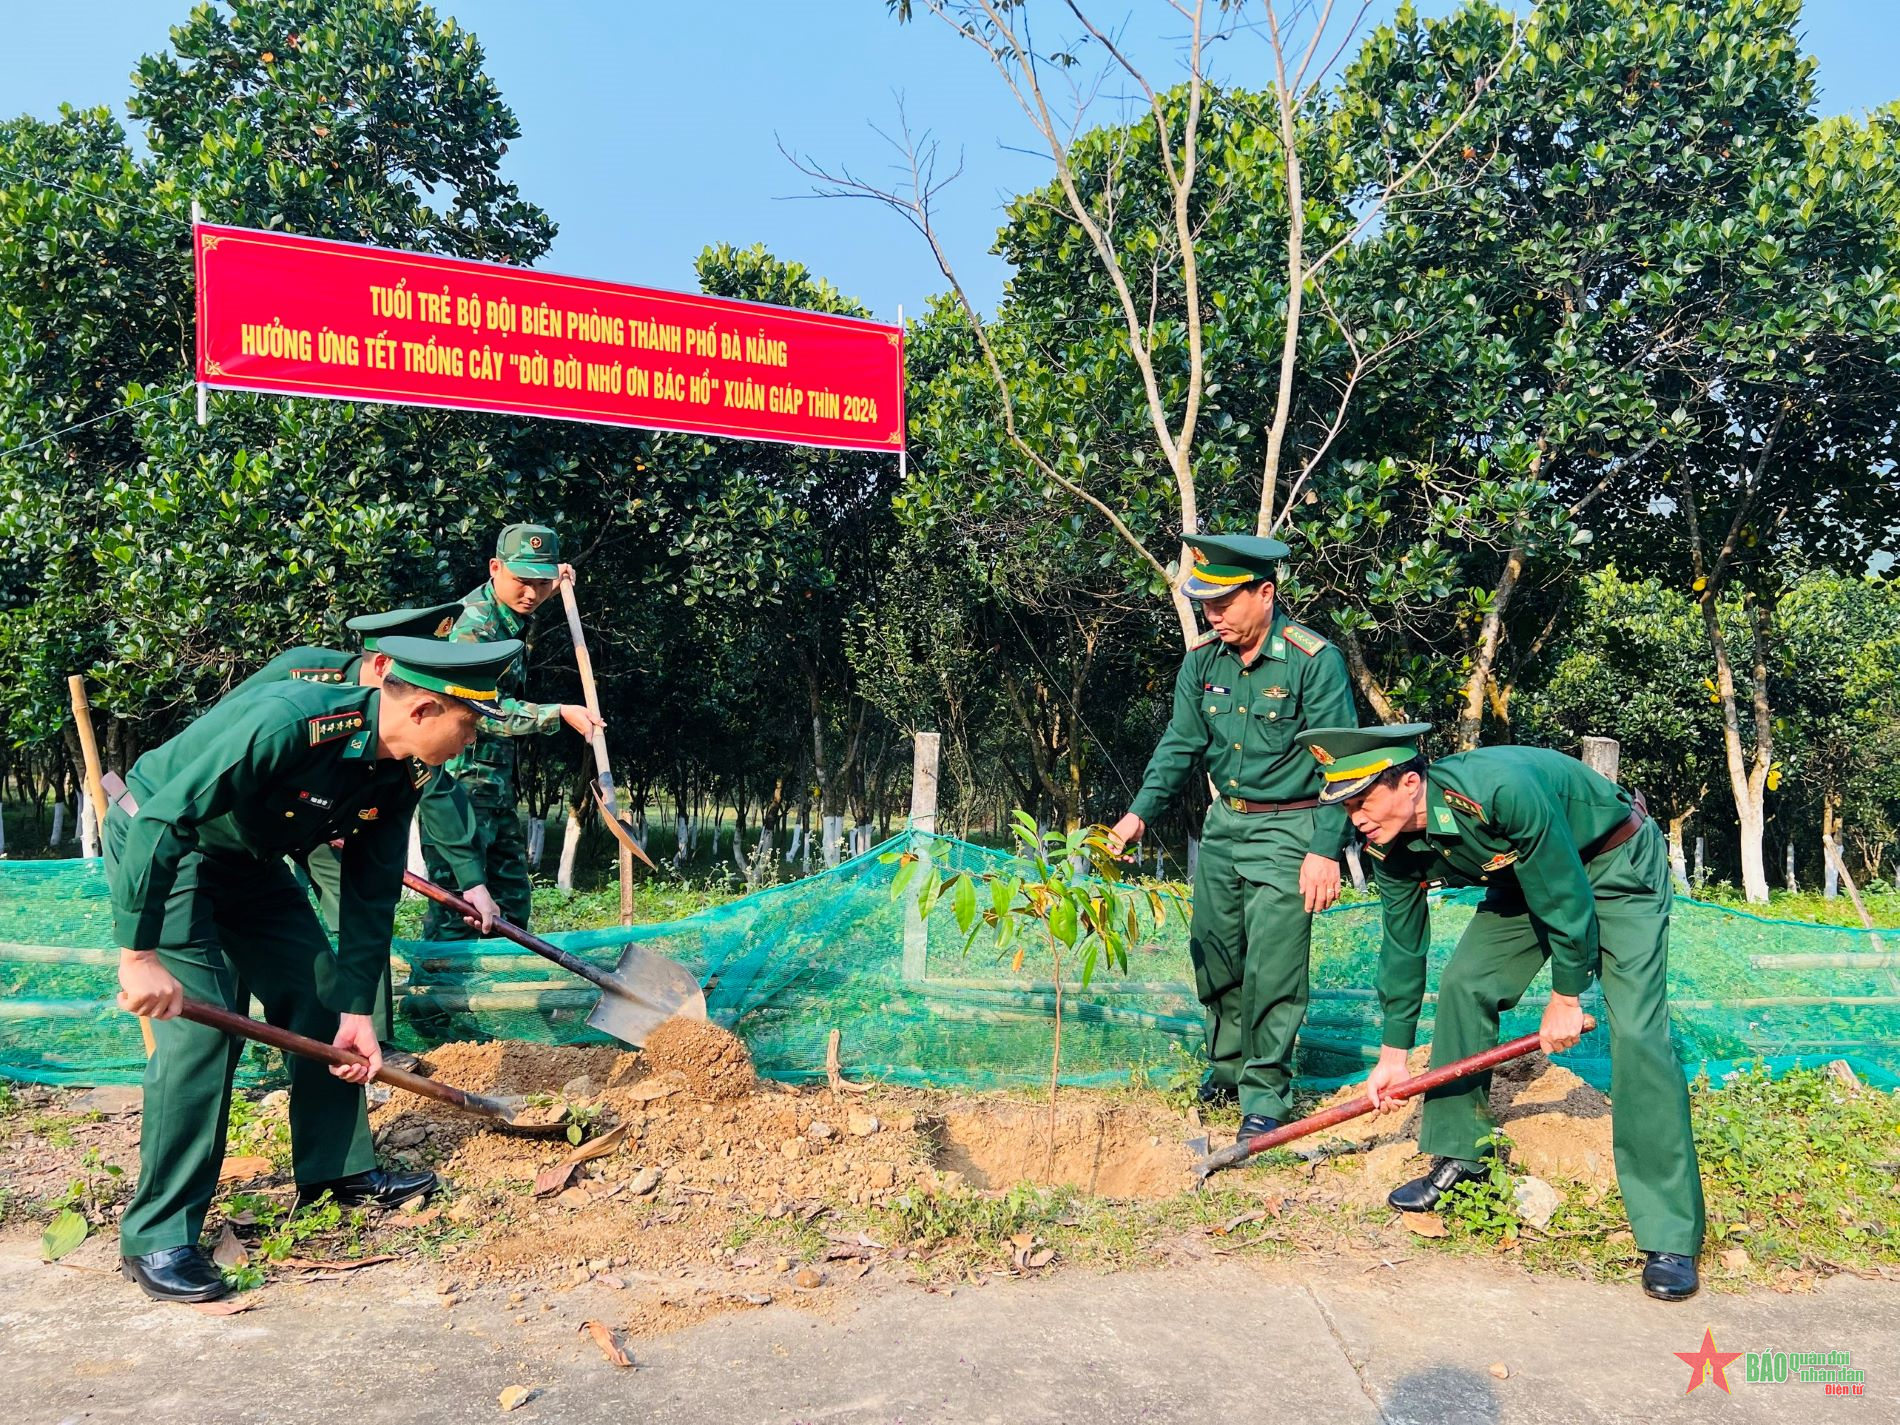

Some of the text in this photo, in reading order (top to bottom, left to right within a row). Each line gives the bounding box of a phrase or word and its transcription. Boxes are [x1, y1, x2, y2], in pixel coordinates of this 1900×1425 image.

[241, 317, 878, 423] HƯỞNG ỨNG TẾT TRỒNG CÂY "ĐỜI ĐỜI NHỚ ƠN BÁC HỒ" XUÂN GIÁP THÌN 2024
[370, 277, 788, 367] TUỔI TRẺ BỘ ĐỘI BIÊN PHÒNG THÀNH PHỐ ĐÀ NẴNG
